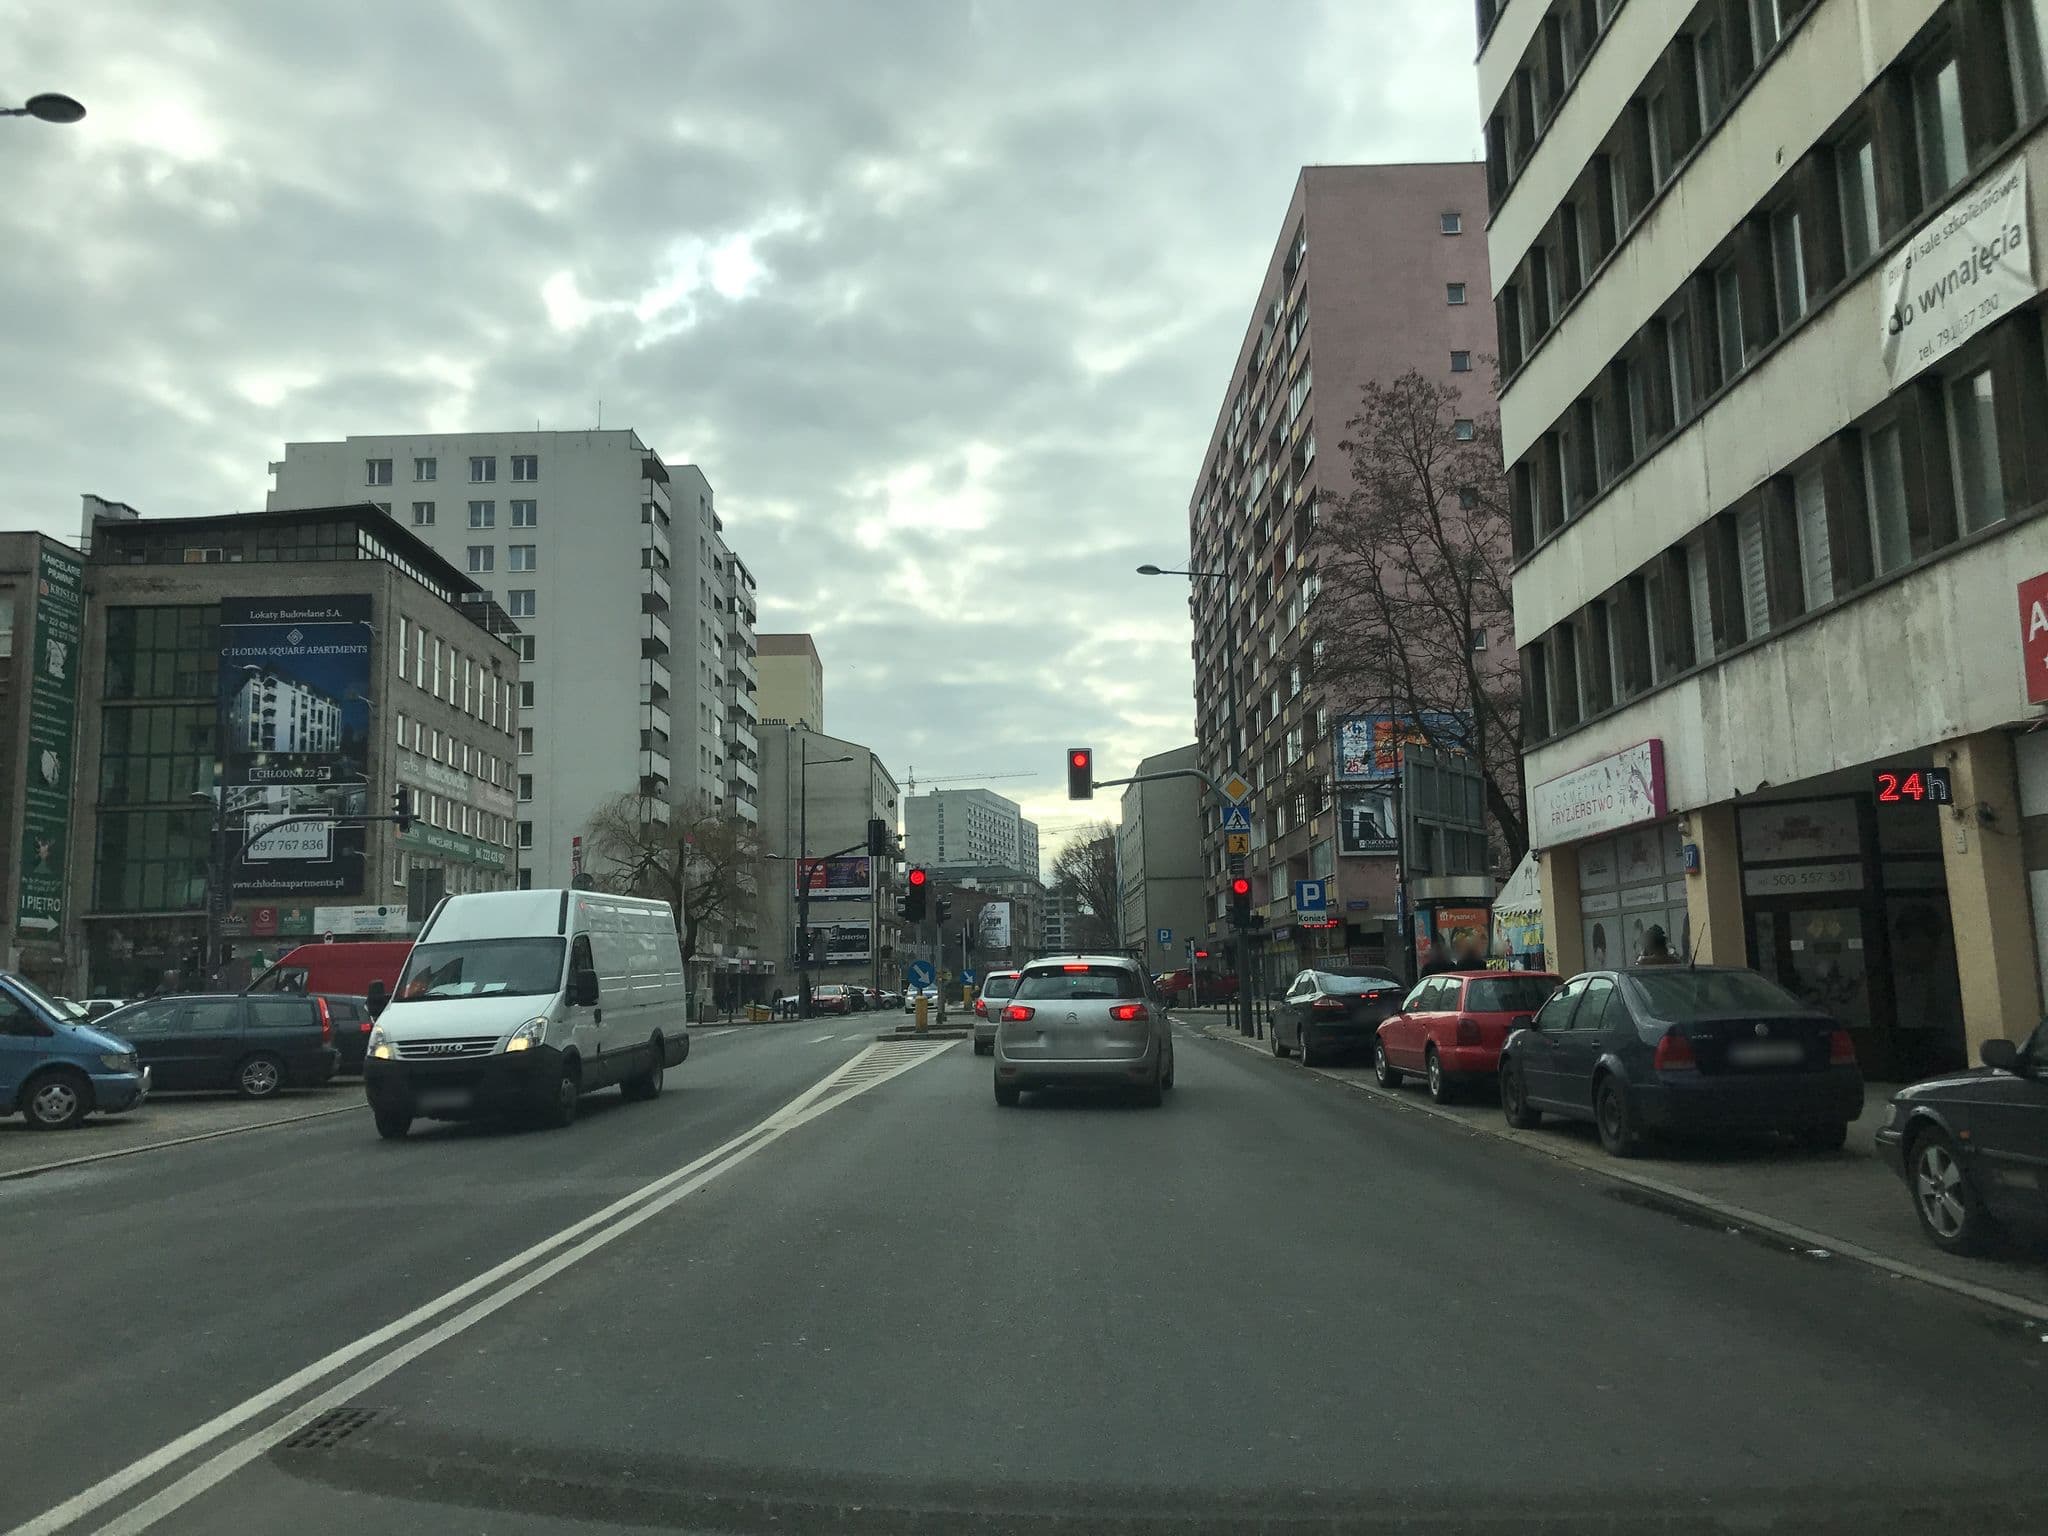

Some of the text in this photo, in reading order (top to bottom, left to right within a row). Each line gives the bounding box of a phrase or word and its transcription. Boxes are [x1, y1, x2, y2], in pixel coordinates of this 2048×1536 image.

[1920, 233, 1941, 257] sale
[1943, 177, 2019, 240] szkoleniowe
[1889, 224, 2021, 335] do wynajęcia
[1919, 340, 1935, 361] tel.
[250, 609, 342, 620] Lokaty Budowlane S.A.
[269, 647, 304, 656] SQUARE
[307, 645, 368, 655] APARTMENTS
[257, 769, 302, 778] CHŁODNA
[305, 769, 317, 778] 22
[1878, 773, 1946, 800] 24h
[1551, 795, 1613, 825] FRYZJERSTWO
[302, 822, 324, 833] 770
[252, 839, 324, 852] 697 767 836
[1302, 883, 1320, 907] P
[27, 896, 61, 914] PIĘTRO
[1298, 912, 1326, 923] Koniec
[428, 1043, 463, 1054] IVECO
